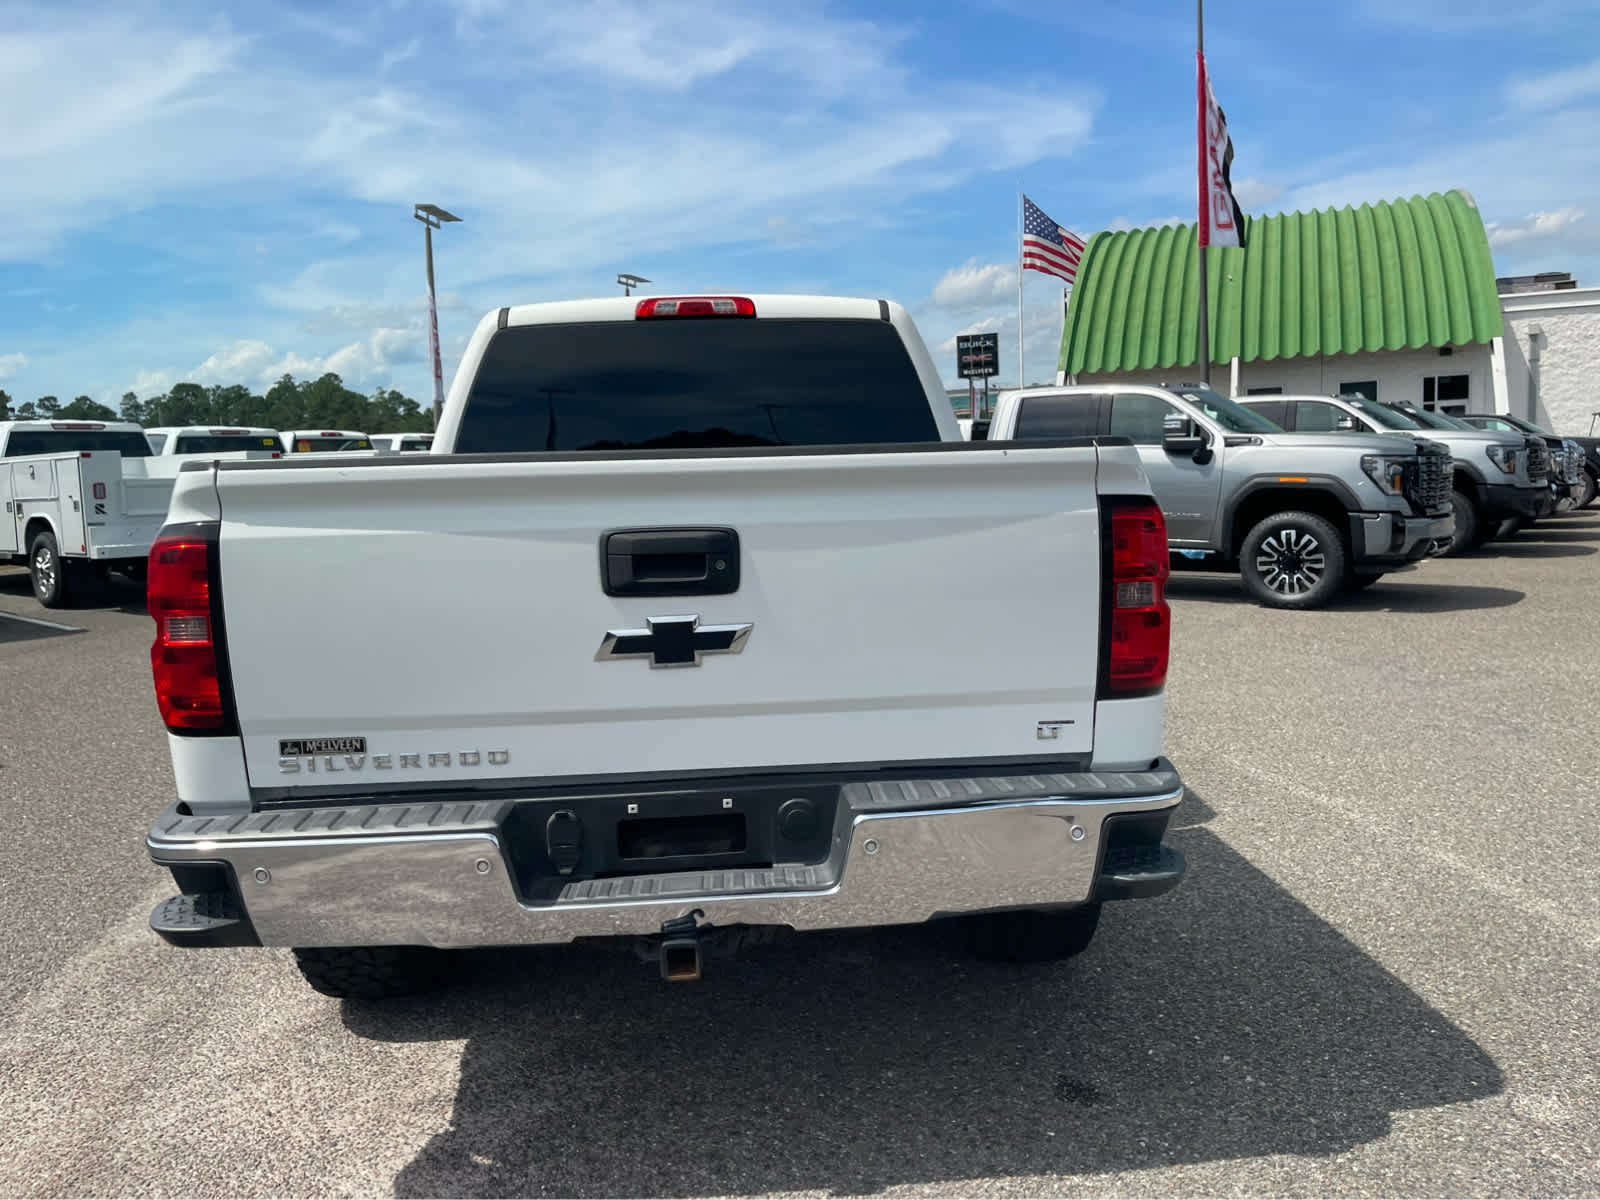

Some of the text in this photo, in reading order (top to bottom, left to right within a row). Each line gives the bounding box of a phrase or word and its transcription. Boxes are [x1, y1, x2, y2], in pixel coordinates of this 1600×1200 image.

[959, 340, 994, 349] BUICK
[961, 353, 993, 363] GMC
[1037, 720, 1075, 740] LT
[278, 748, 511, 774] SILVERADO
